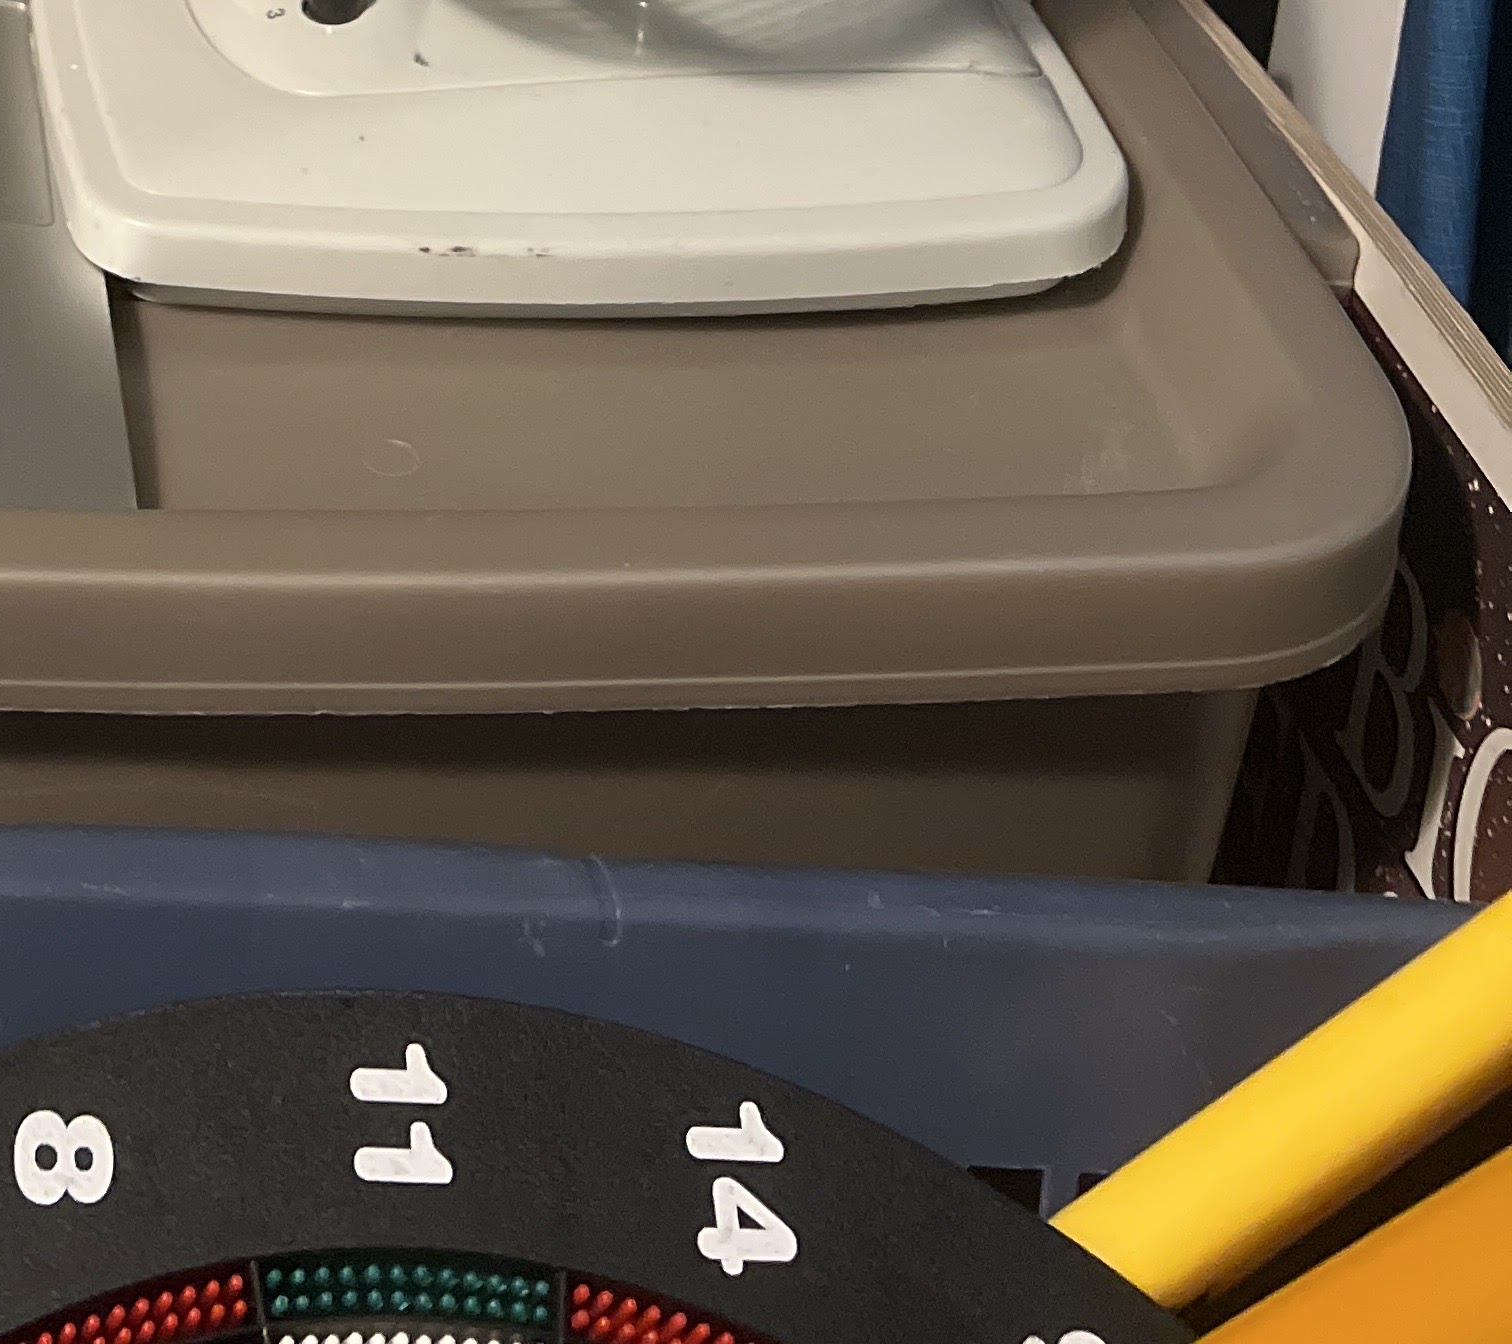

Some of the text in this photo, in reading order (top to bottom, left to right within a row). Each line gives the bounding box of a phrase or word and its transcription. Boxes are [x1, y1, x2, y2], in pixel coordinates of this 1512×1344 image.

[267, 8, 286, 19] 3
[13, 1109, 114, 1206] 8
[349, 1043, 454, 1184] 11
[685, 1101, 798, 1276] 14
